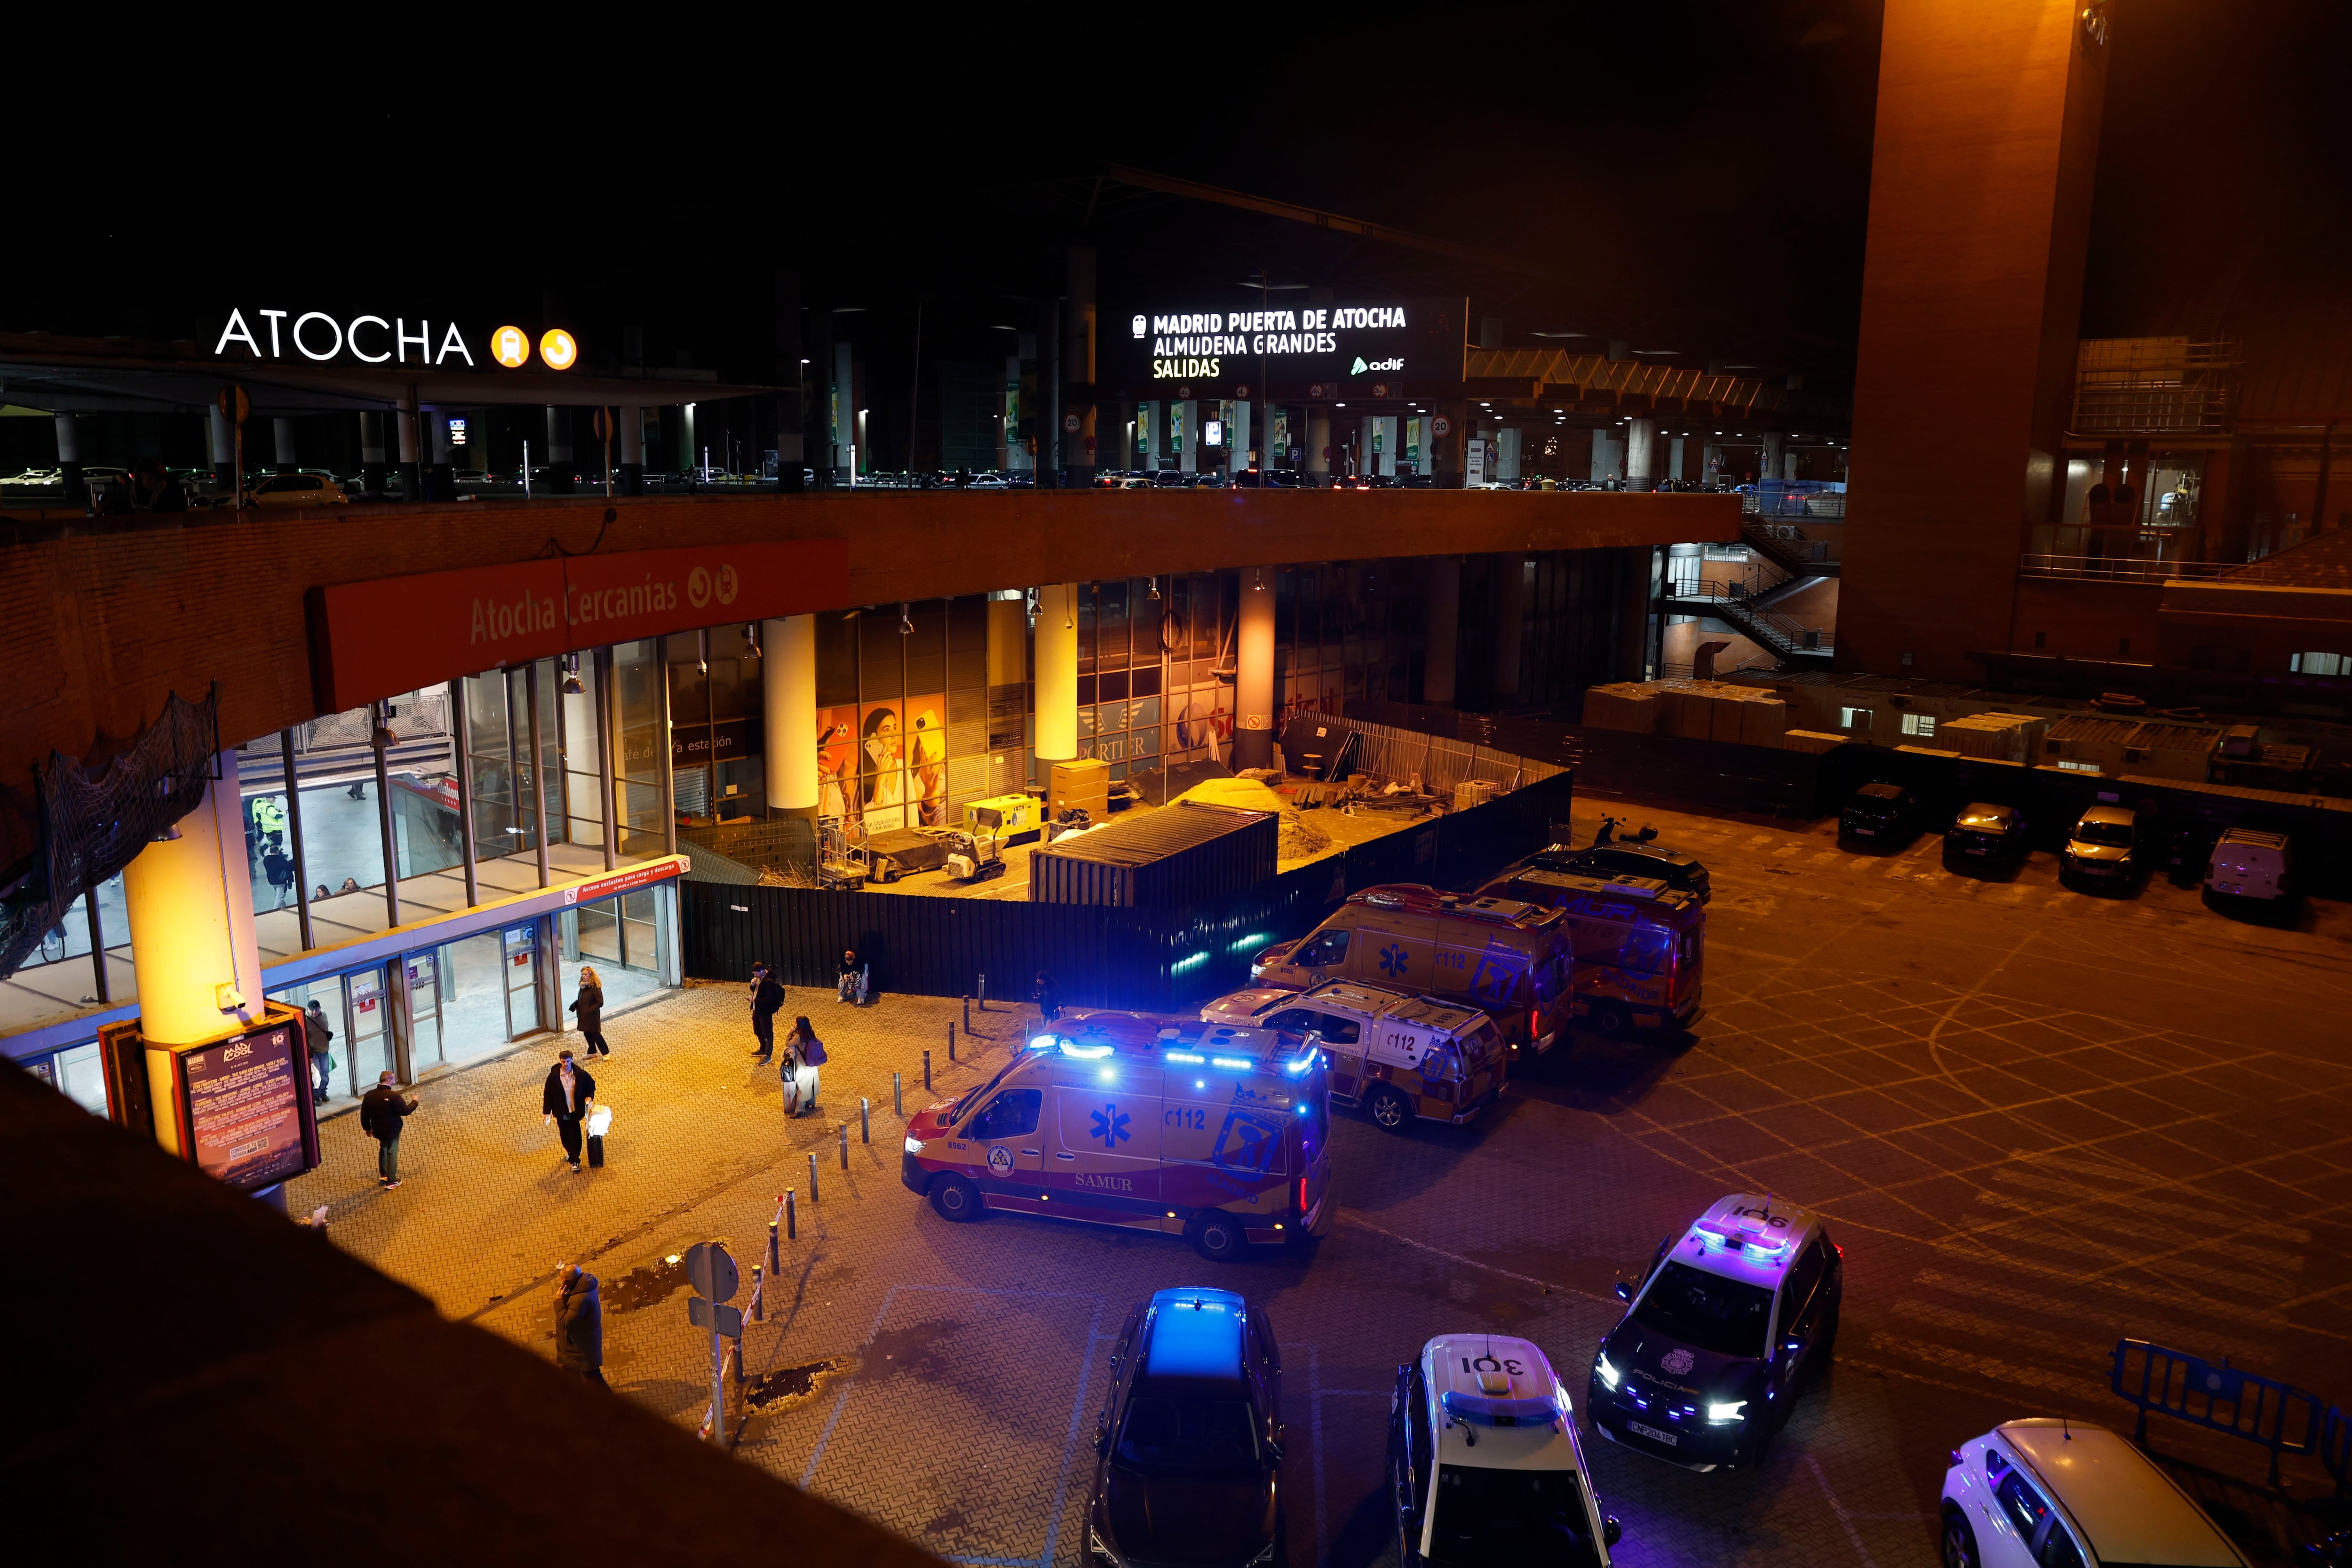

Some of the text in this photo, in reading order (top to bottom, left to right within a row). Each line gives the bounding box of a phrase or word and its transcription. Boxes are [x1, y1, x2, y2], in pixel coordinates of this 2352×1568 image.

[1153, 307, 1406, 334] MADRID PUERTA DE ATOCHA
[215, 307, 474, 366] ATOCHA
[1153, 333, 1336, 357] ALMUDENA GRANDES
[1153, 358, 1220, 378] SALIDAS
[1369, 358, 1405, 371] adif
[1293, 450, 1299, 459] P
[470, 572, 677, 645] Atocha Cercanías
[623, 748, 639, 761] afé
[601, 878, 623, 888] exclusivo
[654, 864, 675, 873] descarga
[1358, 924, 1389, 933] AMBULANCIA
[1444, 951, 1465, 970] 112
[1600, 968, 1652, 1000] MADRID
[1226, 1017, 1247, 1026] SAMUR
[272, 1035, 284, 1045] 10
[1395, 1033, 1415, 1051] 112
[187, 1055, 204, 1066] MADRID
[223, 1043, 248, 1063] MAD
[225, 1043, 254, 1062] COOL
[201, 1079, 218, 1087] FIGHTERS
[1054, 1080, 1097, 1090] AMBULANCIA
[198, 1117, 213, 1125] TWENTY
[1176, 1108, 1205, 1130] 112
[231, 1144, 252, 1154] CONSIGUE
[231, 1149, 247, 1160] ENTRADA
[948, 1142, 966, 1150] 8562
[1075, 1173, 1132, 1192] SAMUR
[1206, 1173, 1258, 1204] MADRID
[1633, 1369, 1685, 1393] POLICIA
